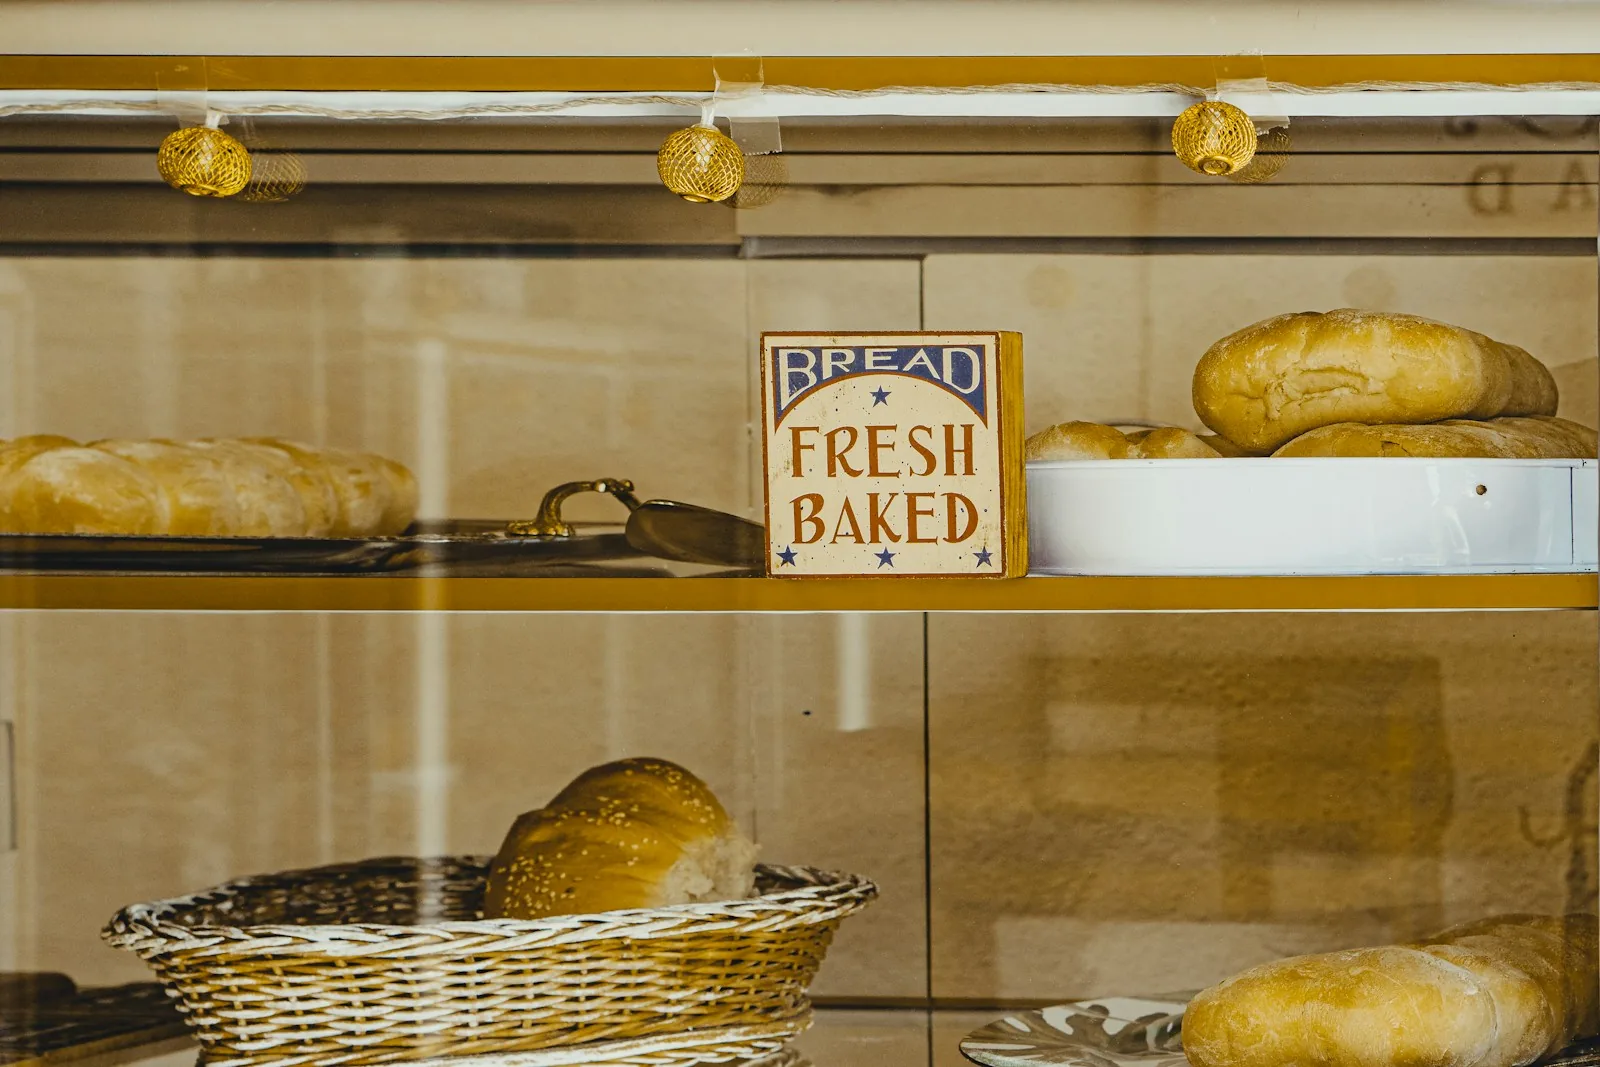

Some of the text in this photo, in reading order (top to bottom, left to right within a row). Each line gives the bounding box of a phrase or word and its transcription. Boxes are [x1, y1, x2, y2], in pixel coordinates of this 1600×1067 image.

[779, 347, 981, 411] BREAD
[787, 423, 976, 478] FRESH
[789, 491, 979, 545] BAKED
